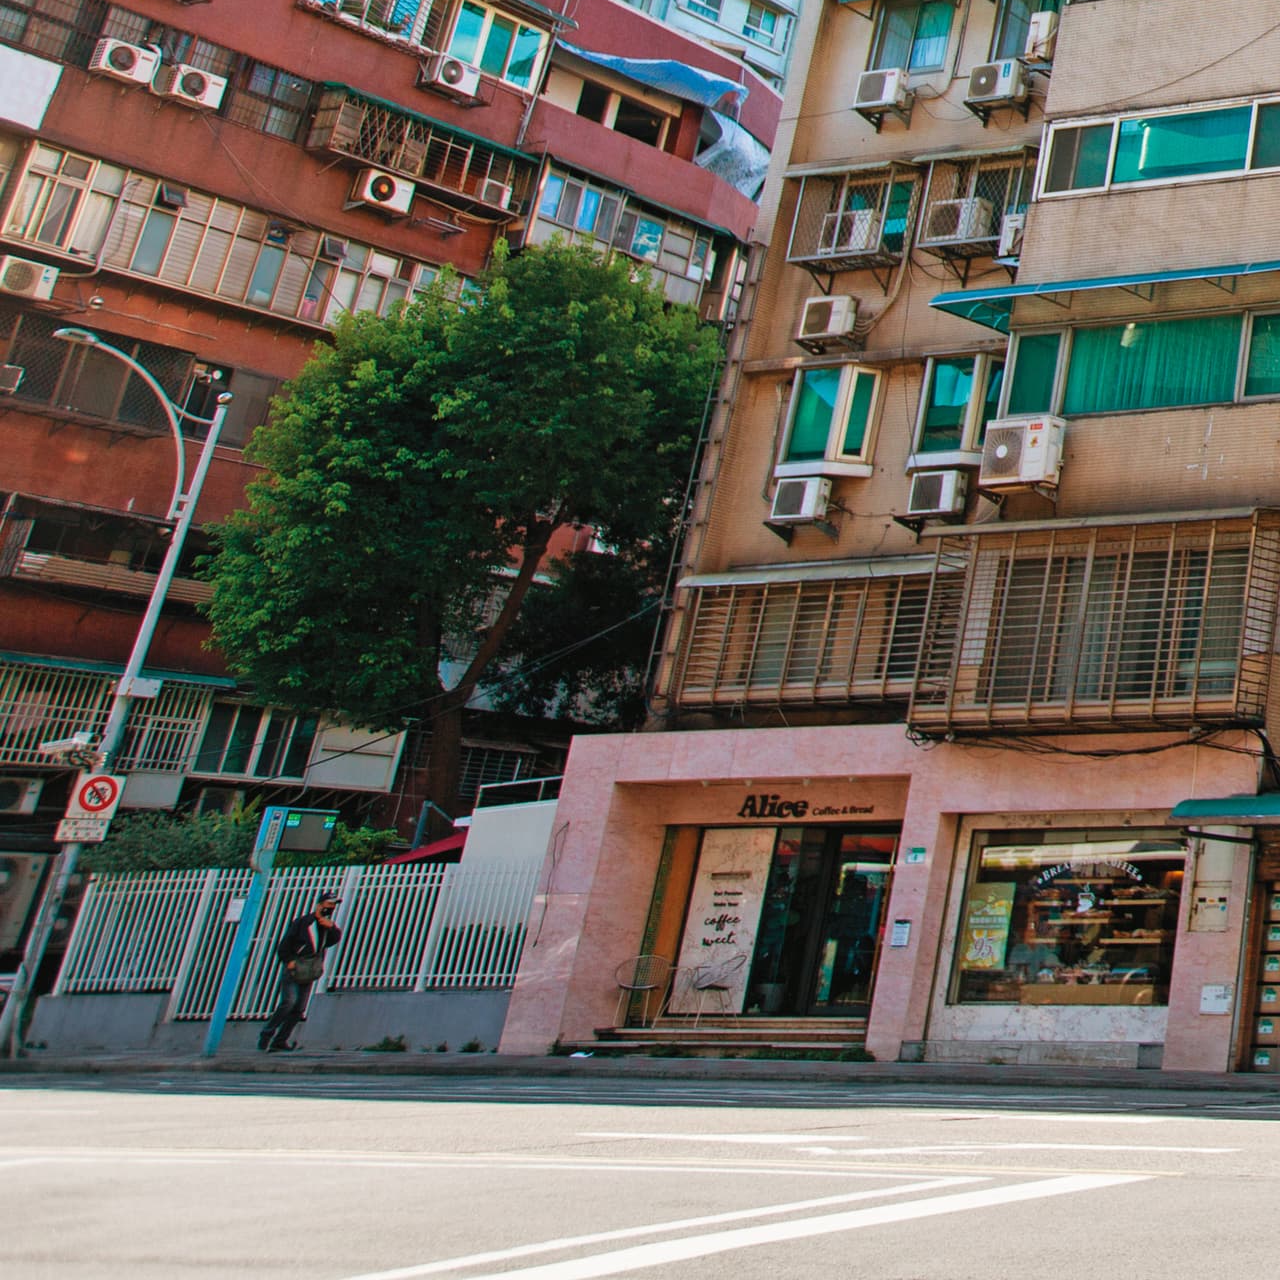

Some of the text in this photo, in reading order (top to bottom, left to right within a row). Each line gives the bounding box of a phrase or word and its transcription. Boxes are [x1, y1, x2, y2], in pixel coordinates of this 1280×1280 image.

[737, 794, 809, 818] Alice
[812, 805, 840, 816] Coffee
[849, 804, 875, 814] Bread
[704, 914, 741, 931] coffee
